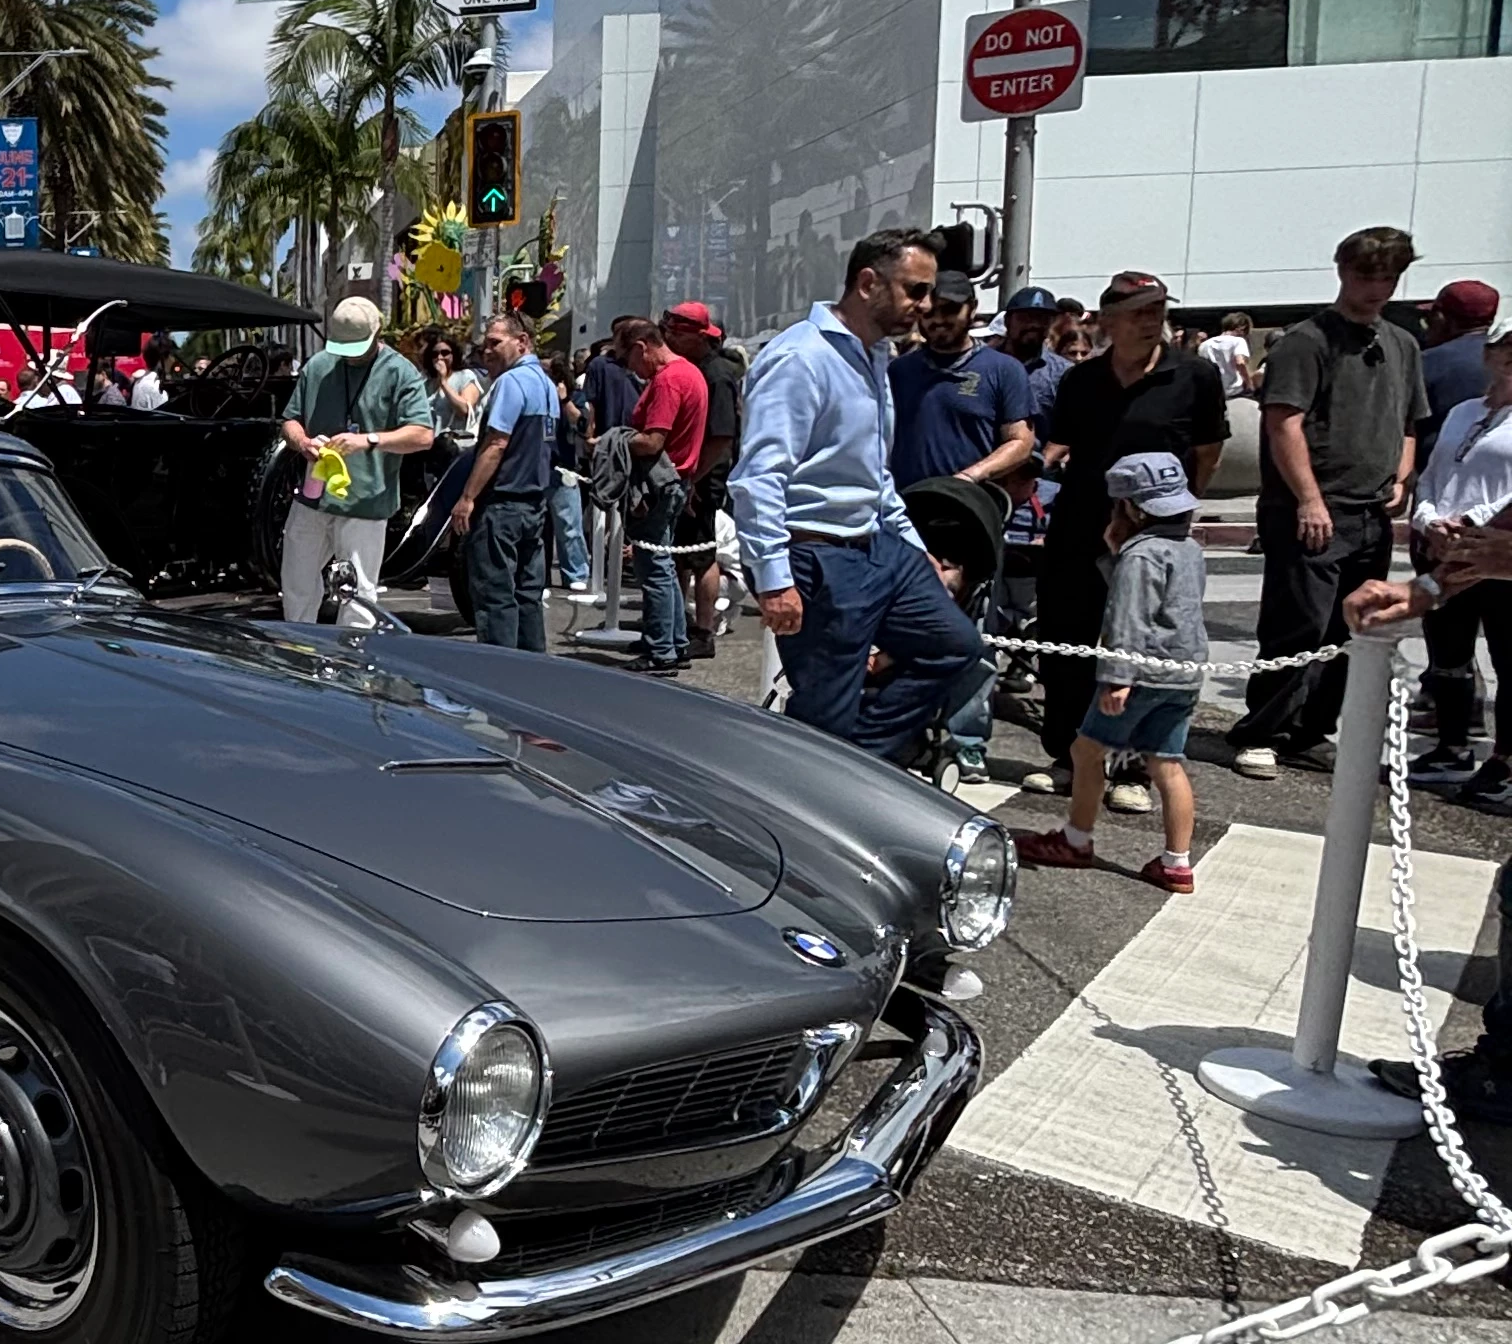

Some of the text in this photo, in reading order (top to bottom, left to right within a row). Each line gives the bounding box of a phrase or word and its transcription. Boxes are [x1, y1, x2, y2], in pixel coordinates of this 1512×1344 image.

[984, 24, 1066, 52] DO NOT
[990, 73, 1055, 99] ENTER
[1, 167, 26, 187] 21
